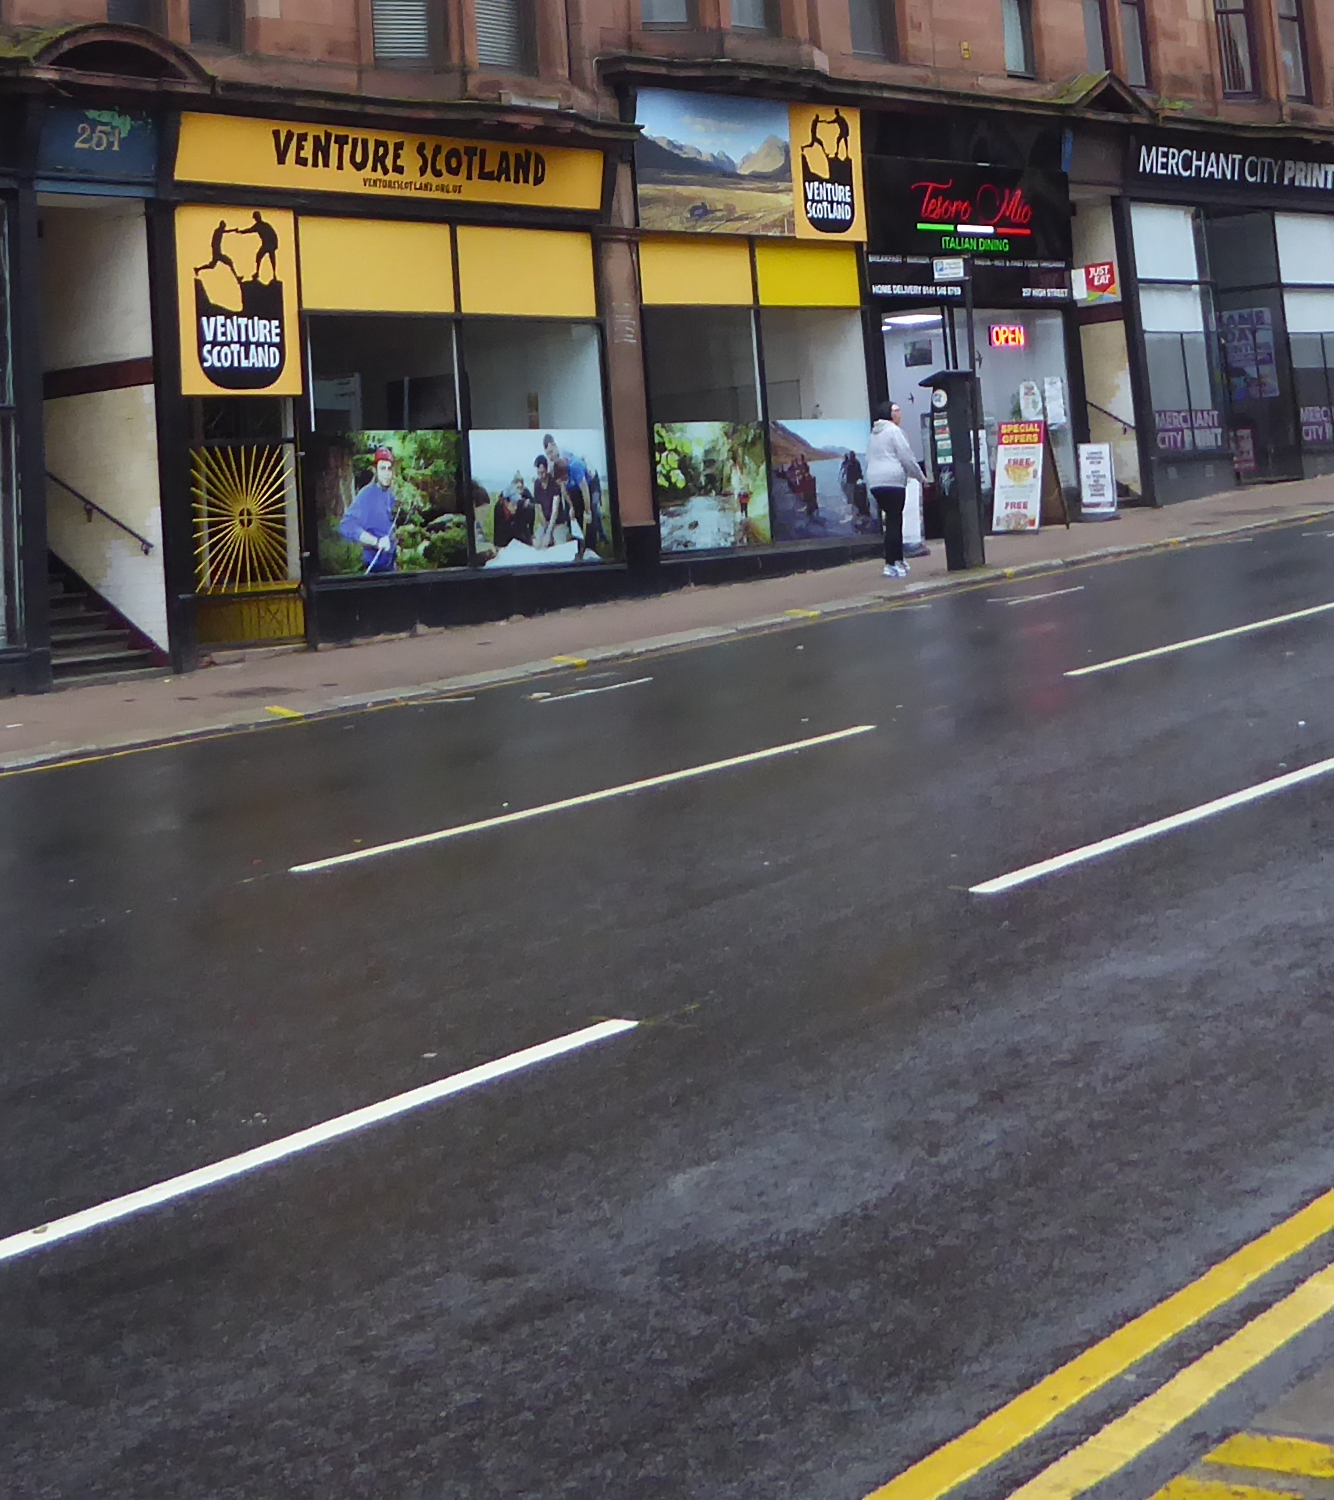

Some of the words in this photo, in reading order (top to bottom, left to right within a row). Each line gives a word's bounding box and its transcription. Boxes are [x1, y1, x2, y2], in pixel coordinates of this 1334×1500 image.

[74, 123, 121, 151] 251
[271, 128, 406, 177] VENTURE
[416, 141, 546, 187] SCOTLAND
[1138, 144, 1243, 182] MERCHANT
[1244, 155, 1282, 185] CITY
[805, 181, 852, 203] VENTURE
[806, 201, 852, 220] SCOTLAND
[941, 236, 977, 251] ITALIAN
[978, 237, 1009, 252] DINING
[1088, 265, 1110, 279] JUST
[1094, 274, 1111, 286] EAT
[892, 284, 922, 295] DELIVERY
[201, 315, 281, 343] VENTURE
[992, 326, 1025, 346] OPEN
[202, 343, 281, 368] SCOTLAND
[1000, 423, 1040, 434] SPECIAL
[1302, 424, 1325, 442] CITY
[1001, 433, 1039, 444] OFFERS
[1156, 429, 1183, 449] CITY
[1004, 501, 1029, 510] FREE
